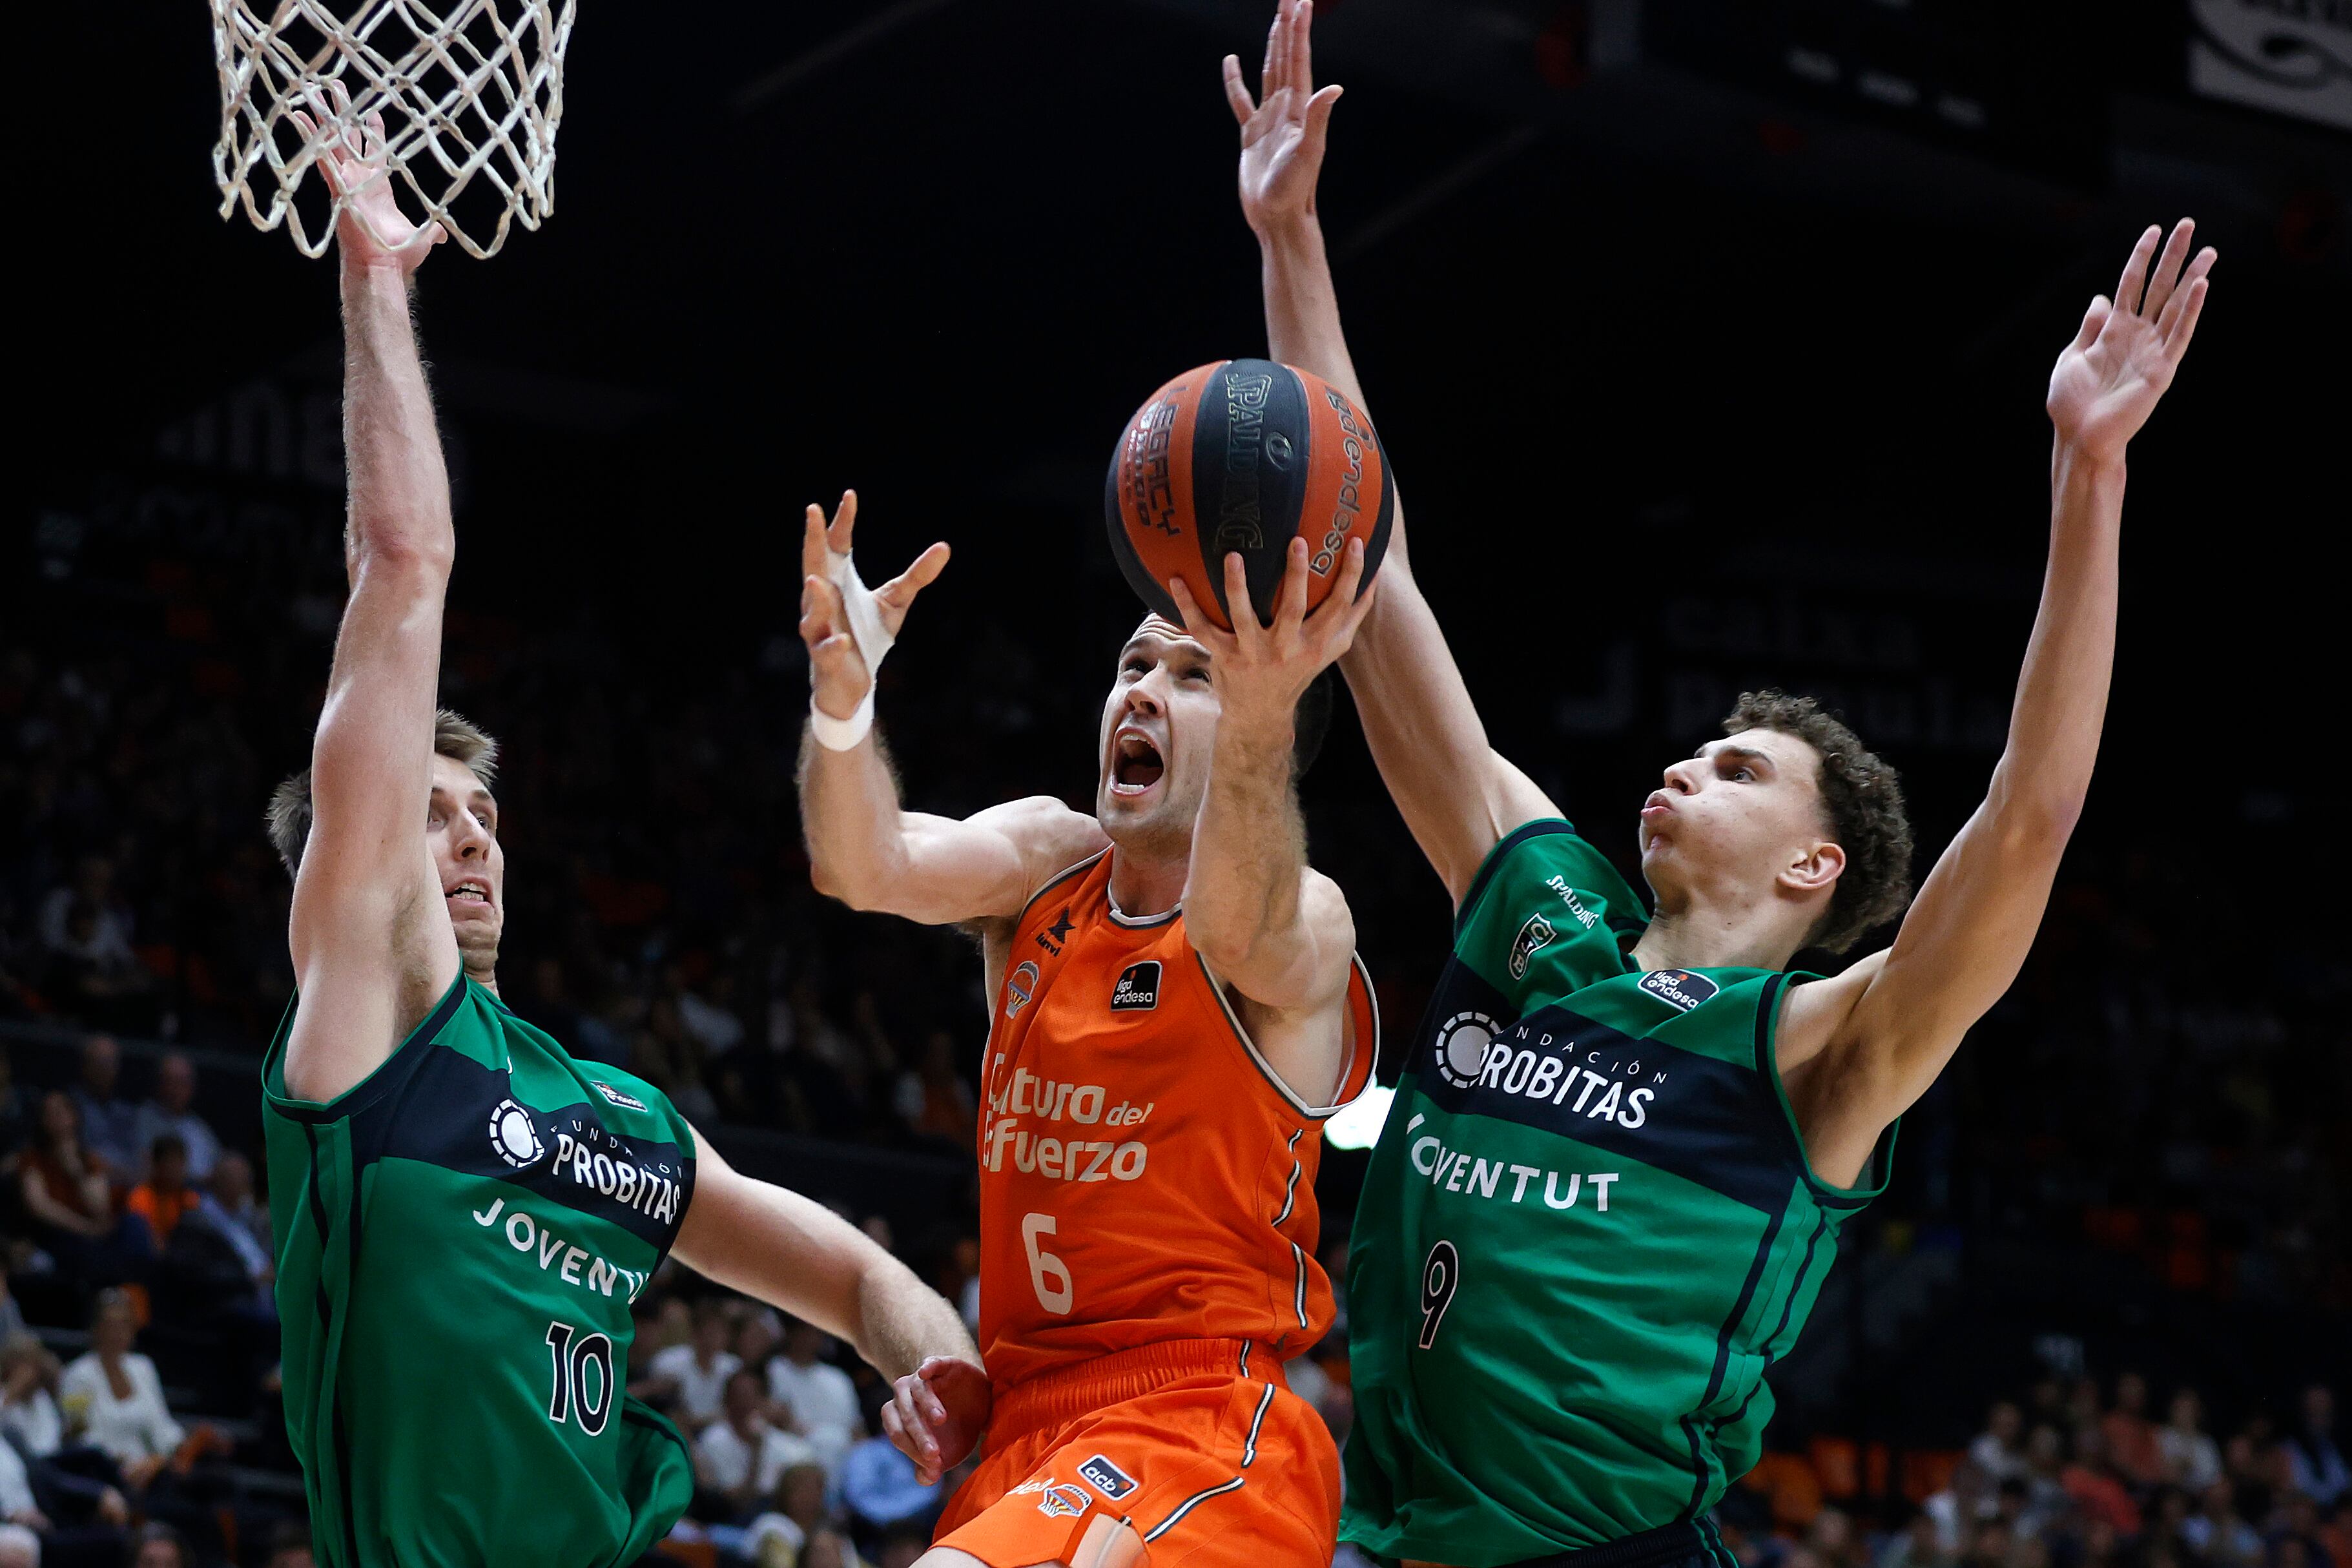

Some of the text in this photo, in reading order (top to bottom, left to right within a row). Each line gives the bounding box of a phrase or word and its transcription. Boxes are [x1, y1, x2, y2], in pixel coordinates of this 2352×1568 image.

[1308, 437, 1363, 577] endesa
[1546, 874, 1600, 930] SPALDING
[1113, 990, 1153, 1005] endesa
[1117, 979, 1133, 993] liga
[1647, 979, 1699, 1008] endesa
[1654, 971, 1680, 986] liga
[1516, 1026, 1667, 1084] NDACIÓN
[1105, 1100, 1154, 1126] del
[1022, 1212, 1073, 1315] 6
[1419, 1239, 1458, 1349] 9
[546, 1321, 614, 1436] 10
[1085, 1466, 1116, 1491] acb
